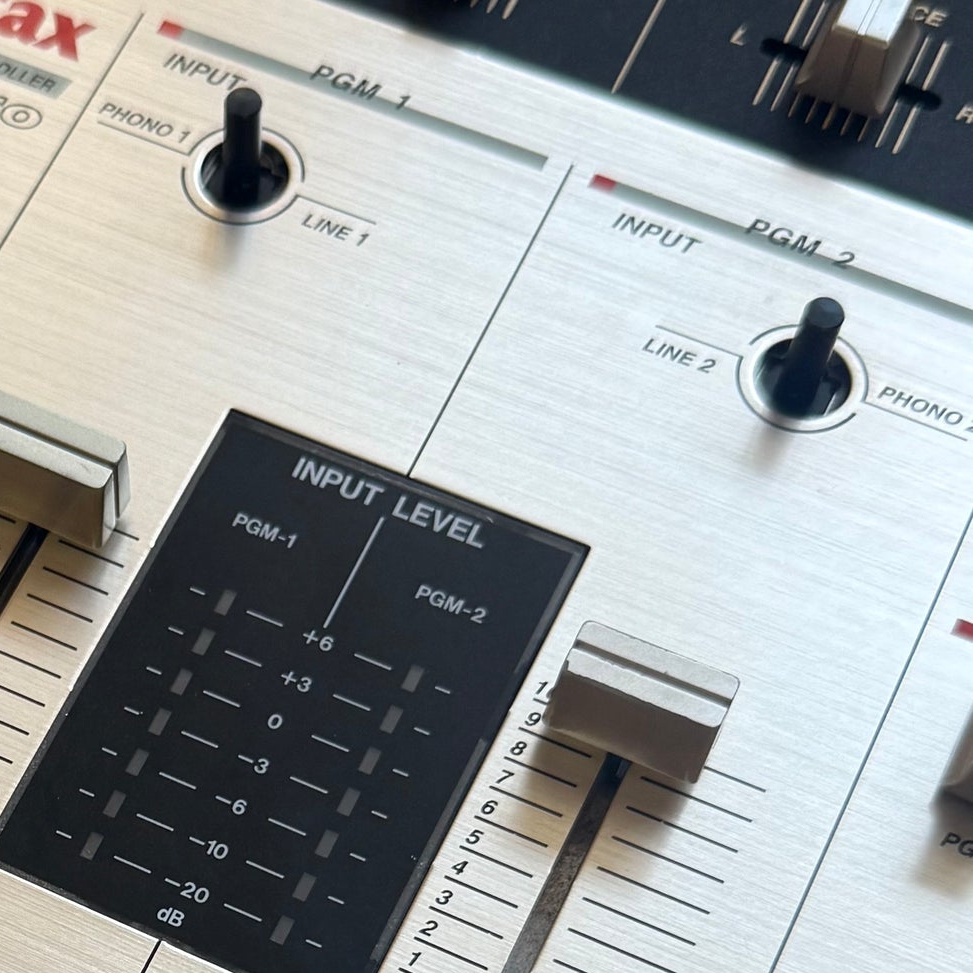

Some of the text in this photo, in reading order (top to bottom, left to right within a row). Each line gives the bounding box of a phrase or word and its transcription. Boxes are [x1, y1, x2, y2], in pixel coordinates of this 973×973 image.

[163, 53, 248, 92] INPUT
[309, 64, 412, 110] PGM 1
[98, 102, 191, 144] PHONO 1
[301, 213, 370, 246] LINE 1
[611, 213, 703, 254] INPUT
[745, 218, 855, 269] PGM 2
[641, 338, 717, 374] LINE 2
[877, 386, 963, 425] PHONO
[291, 456, 485, 549] INPUT LEVEL
[231, 512, 298, 549] PGM-1
[414, 584, 488, 624] PGM-2
[302, 629, 334, 651] +6
[281, 671, 313, 692] +3
[267, 713, 283, 730] 0
[524, 712, 542, 727] 9
[510, 741, 527, 756] 8
[238, 754, 270, 774] -3
[495, 769, 514, 785] 7
[215, 795, 247, 815] -6
[480, 799, 499, 815] 6
[189, 836, 229, 860] -10
[465, 829, 484, 845] 5
[450, 860, 469, 875] 4
[164, 877, 210, 904] -20
[435, 889, 454, 905] 3
[156, 906, 185, 928] dB
[418, 920, 439, 936] 2
[407, 951, 422, 968] 1
